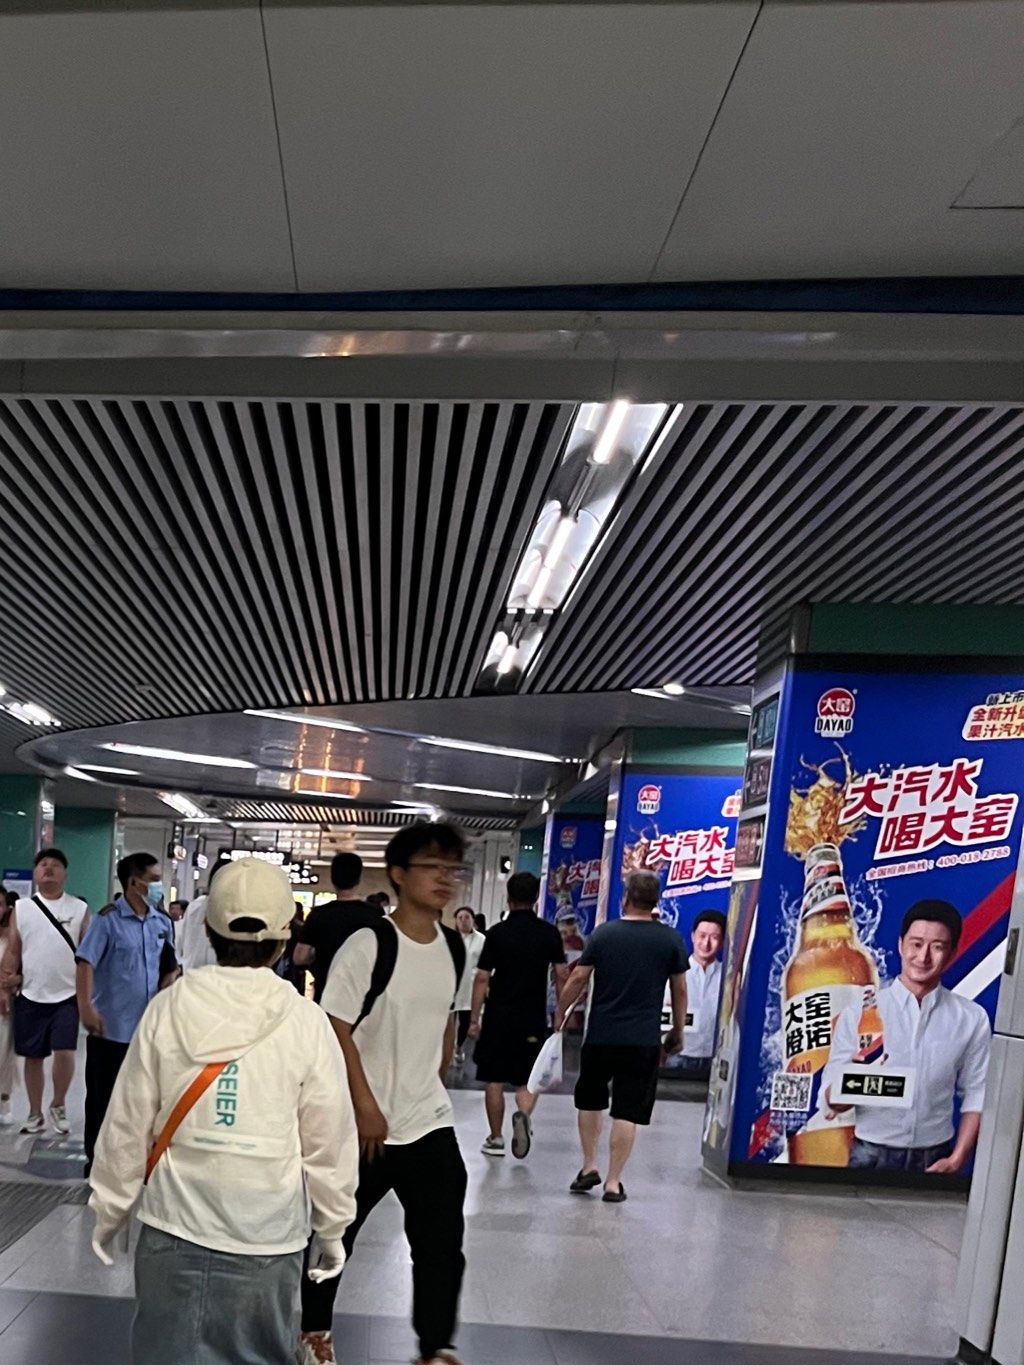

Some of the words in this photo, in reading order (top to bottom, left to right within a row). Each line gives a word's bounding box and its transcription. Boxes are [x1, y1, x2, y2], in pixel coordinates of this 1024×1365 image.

[817, 718, 852, 731] DAYAO
[843, 762, 978, 821] 大汽水
[647, 828, 724, 860] 大汽水
[878, 797, 1015, 854] 喝大窑
